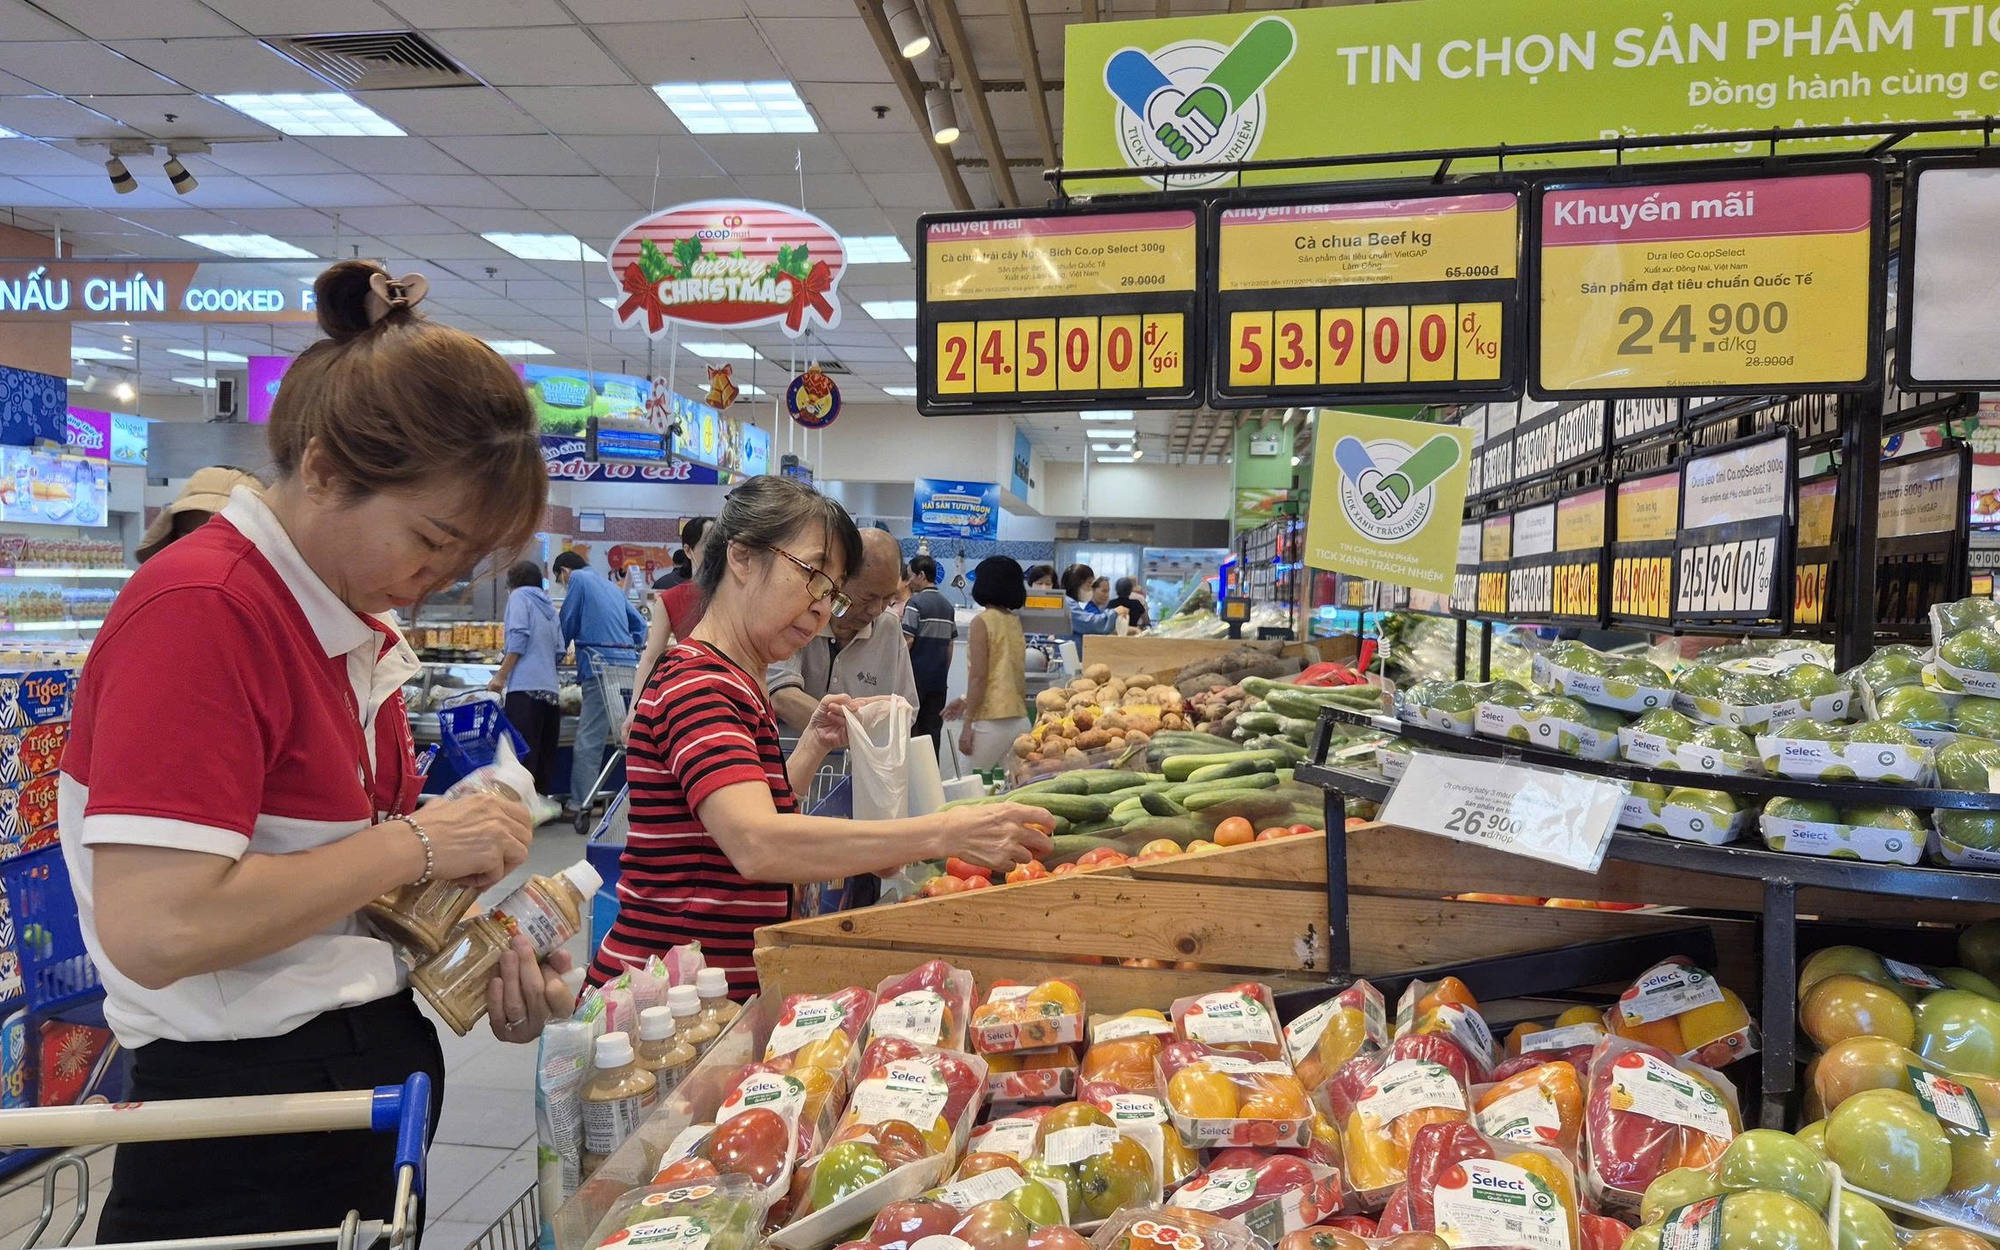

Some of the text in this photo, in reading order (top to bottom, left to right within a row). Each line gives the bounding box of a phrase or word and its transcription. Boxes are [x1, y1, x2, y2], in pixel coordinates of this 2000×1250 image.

[1336, 42, 1421, 85] TIN
[1437, 30, 1596, 85] CHỌN
[1612, 12, 1727, 68] SẢN
[1746, 0, 1915, 59] PHẨM
[1688, 76, 1777, 110] Đồng
[1787, 70, 1871, 101] hành
[1881, 67, 1969, 99] cùng
[1128, 119, 1254, 163] TICK NHIỆM
[1553, 190, 1755, 230] Khuyến mãi
[1321, 234, 1363, 248] chua
[1368, 231, 1407, 246] Beef
[1411, 230, 1433, 247] kg
[1001, 250, 1019, 261] cây
[1050, 247, 1072, 257] Bích
[1074, 246, 1105, 257] Co.op
[1107, 244, 1138, 254] Select
[1140, 242, 1166, 253] 300g
[1394, 249, 1428, 259] VietGAP
[1647, 247, 1747, 261] Dưa leo Co.opSelect
[691, 256, 766, 285] merry
[1445, 264, 1500, 278] 65.000đ
[1729, 262, 1749, 271] Nam
[0, 265, 69, 311] NẤU
[84, 271, 165, 311] CHÍN
[185, 289, 285, 312] COOKED
[1121, 275, 1166, 287] 29.000đ
[1580, 271, 1814, 296] Sản phẩm đạt tiêu chuẩn Quốc Tế
[657, 277, 794, 306] CHRISTMAS
[1616, 301, 1789, 356] 24.900
[1717, 336, 1757, 355] đ/kg
[1744, 355, 1795, 368] 28.900đ
[77, 433, 103, 448] eat
[604, 460, 692, 480] to eat
[1726, 462, 1767, 482] Co.opSelect
[1767, 458, 1785, 474] 300g
[1345, 490, 1427, 536] TICK XANH TRÁCH NHIỆM
[1340, 542, 1420, 564] TIN CHỌN SẢN PHẨM
[1339, 552, 1368, 568] XANH
[1370, 558, 1406, 574] TRÁCH
[1407, 566, 1444, 583] NHIỆM
[25, 676, 67, 705] Tiger
[1571, 679, 1602, 693] Select
[1960, 677, 1998, 689] Select
[1481, 710, 1505, 723] Select
[1772, 706, 1796, 718] Select
[28, 731, 64, 756] Tiger
[1578, 735, 1597, 748] Select
[1632, 738, 1661, 753] Select
[1474, 786, 1490, 796] baby
[1792, 829, 1828, 841] Select
[1642, 970, 1682, 989] Select
[798, 1006, 829, 1017] Select
[1205, 1001, 1240, 1012] Select
[987, 1031, 1013, 1041] Select
[890, 1070, 927, 1084] Select
[1116, 1101, 1154, 1111] Select
[1200, 1126, 1232, 1136] Select
[1472, 1172, 1525, 1191] Select
[634, 1224, 682, 1238] Select
